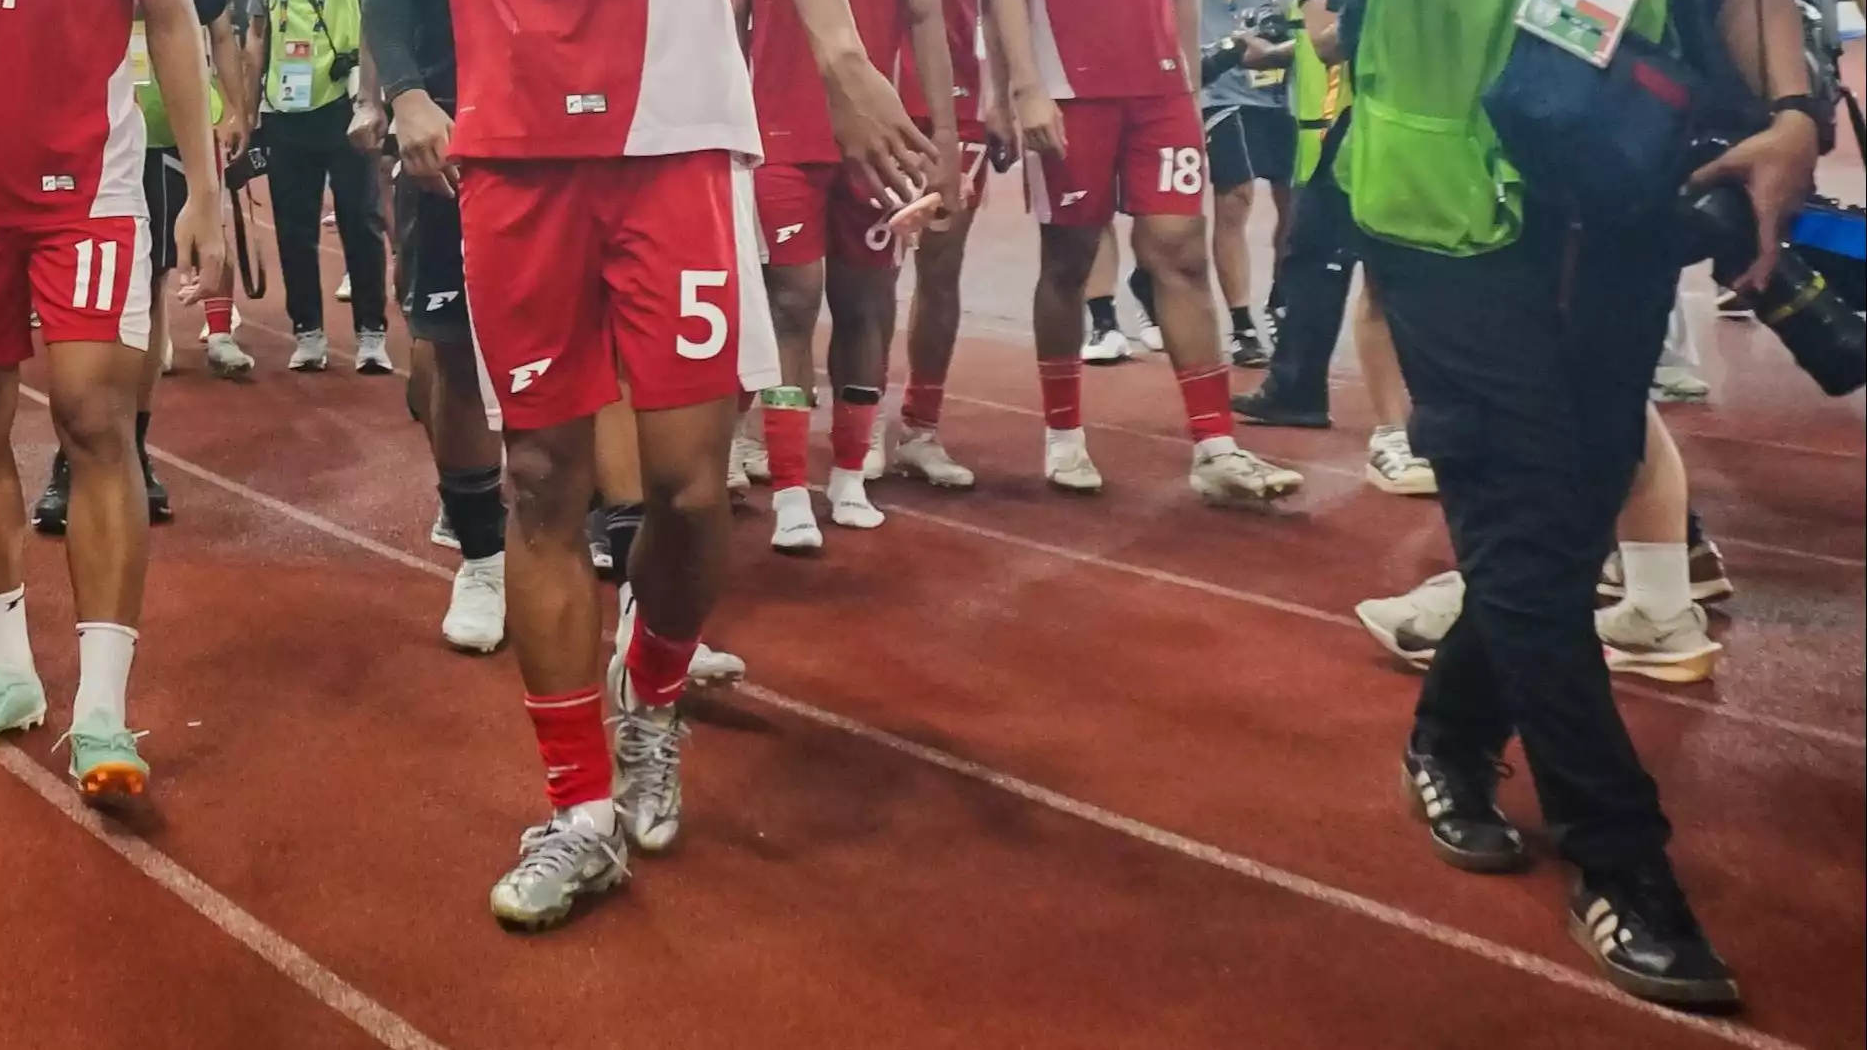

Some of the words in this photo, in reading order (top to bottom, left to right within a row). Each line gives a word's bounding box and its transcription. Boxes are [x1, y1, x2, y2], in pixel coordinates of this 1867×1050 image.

[957, 141, 988, 183] 7
[1158, 146, 1202, 195] 18
[72, 238, 117, 311] 11
[676, 269, 729, 360] 5
